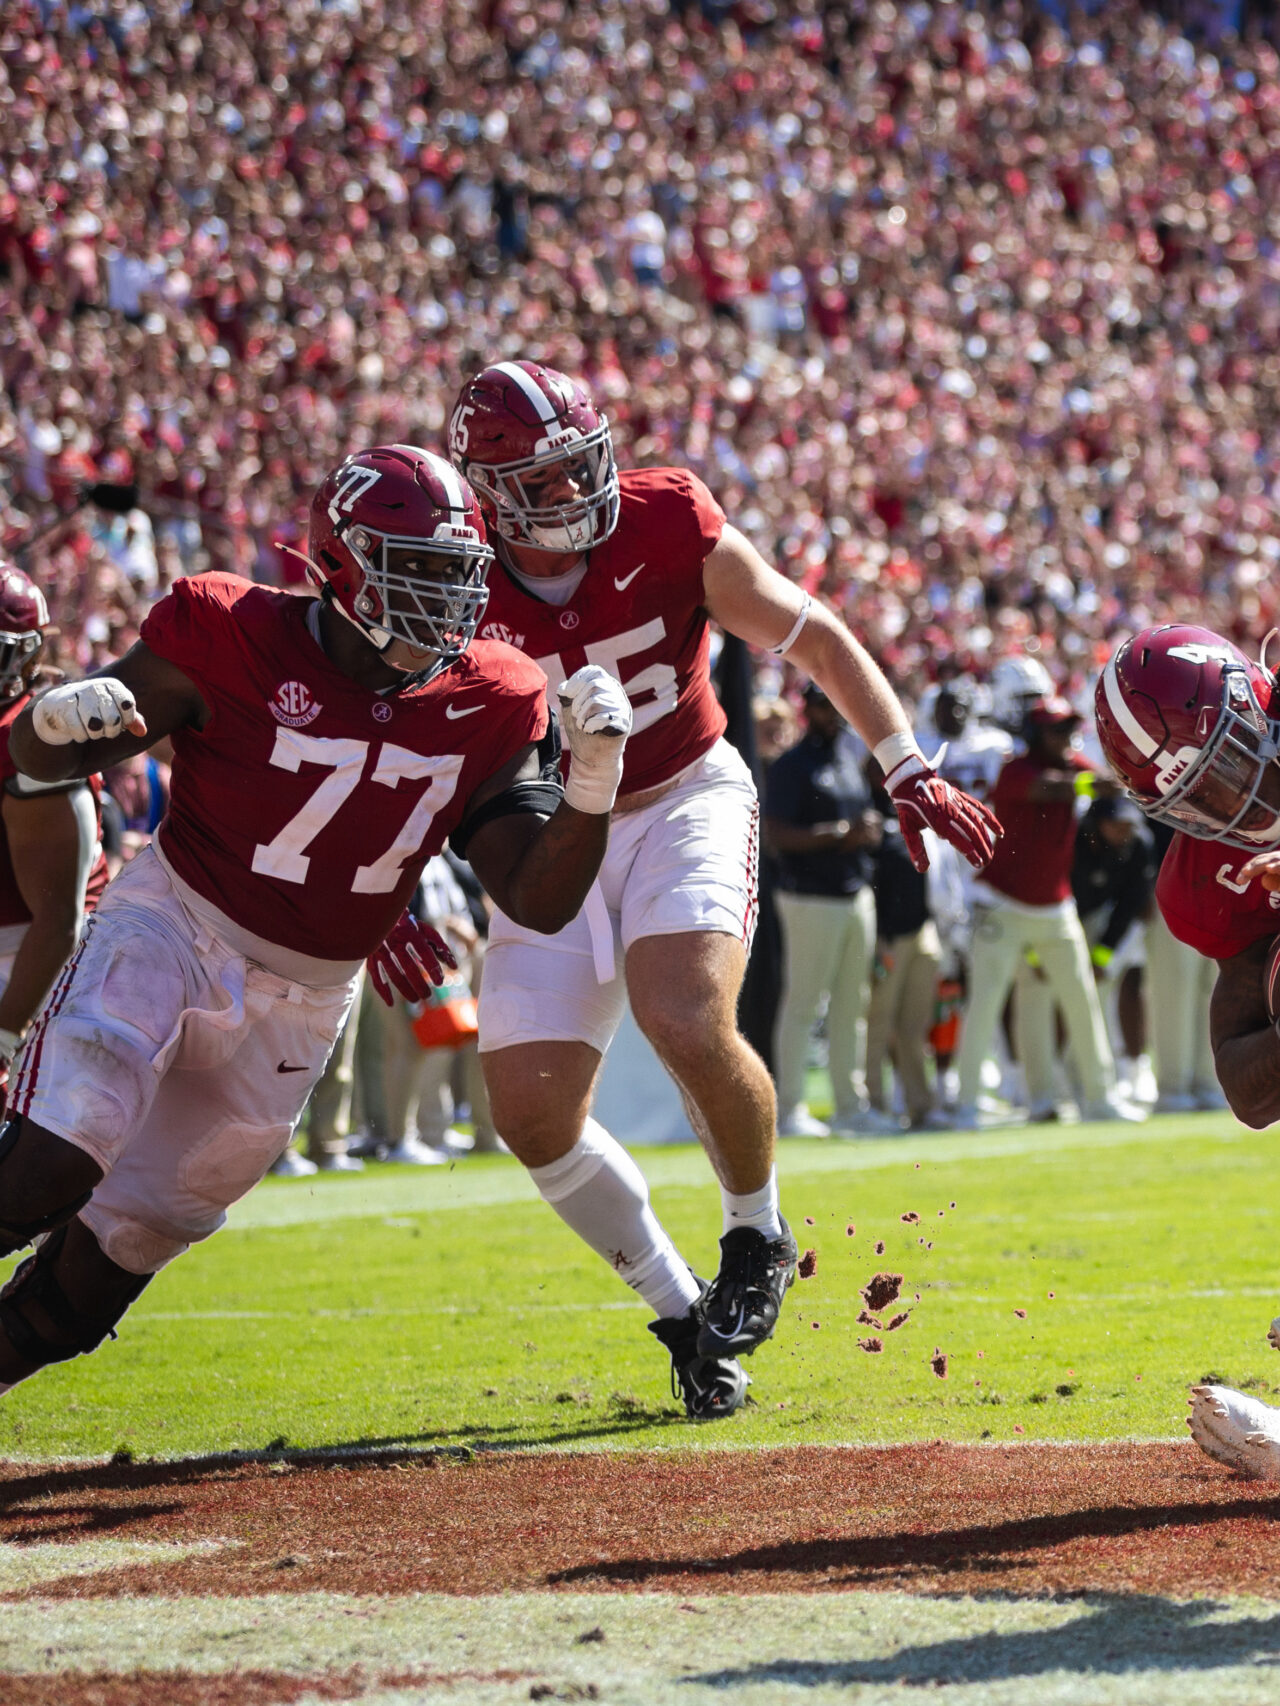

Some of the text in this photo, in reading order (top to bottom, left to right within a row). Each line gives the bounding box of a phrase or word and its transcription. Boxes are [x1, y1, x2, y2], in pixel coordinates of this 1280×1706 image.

[450, 404, 475, 453] 45
[547, 433, 573, 449] BAMA
[330, 466, 382, 512] 77
[451, 528, 473, 538] BAMA
[277, 681, 310, 715] SEC
[274, 709, 316, 726] GRADUATE
[1162, 760, 1188, 785] BAMA
[251, 726, 465, 894] 77
